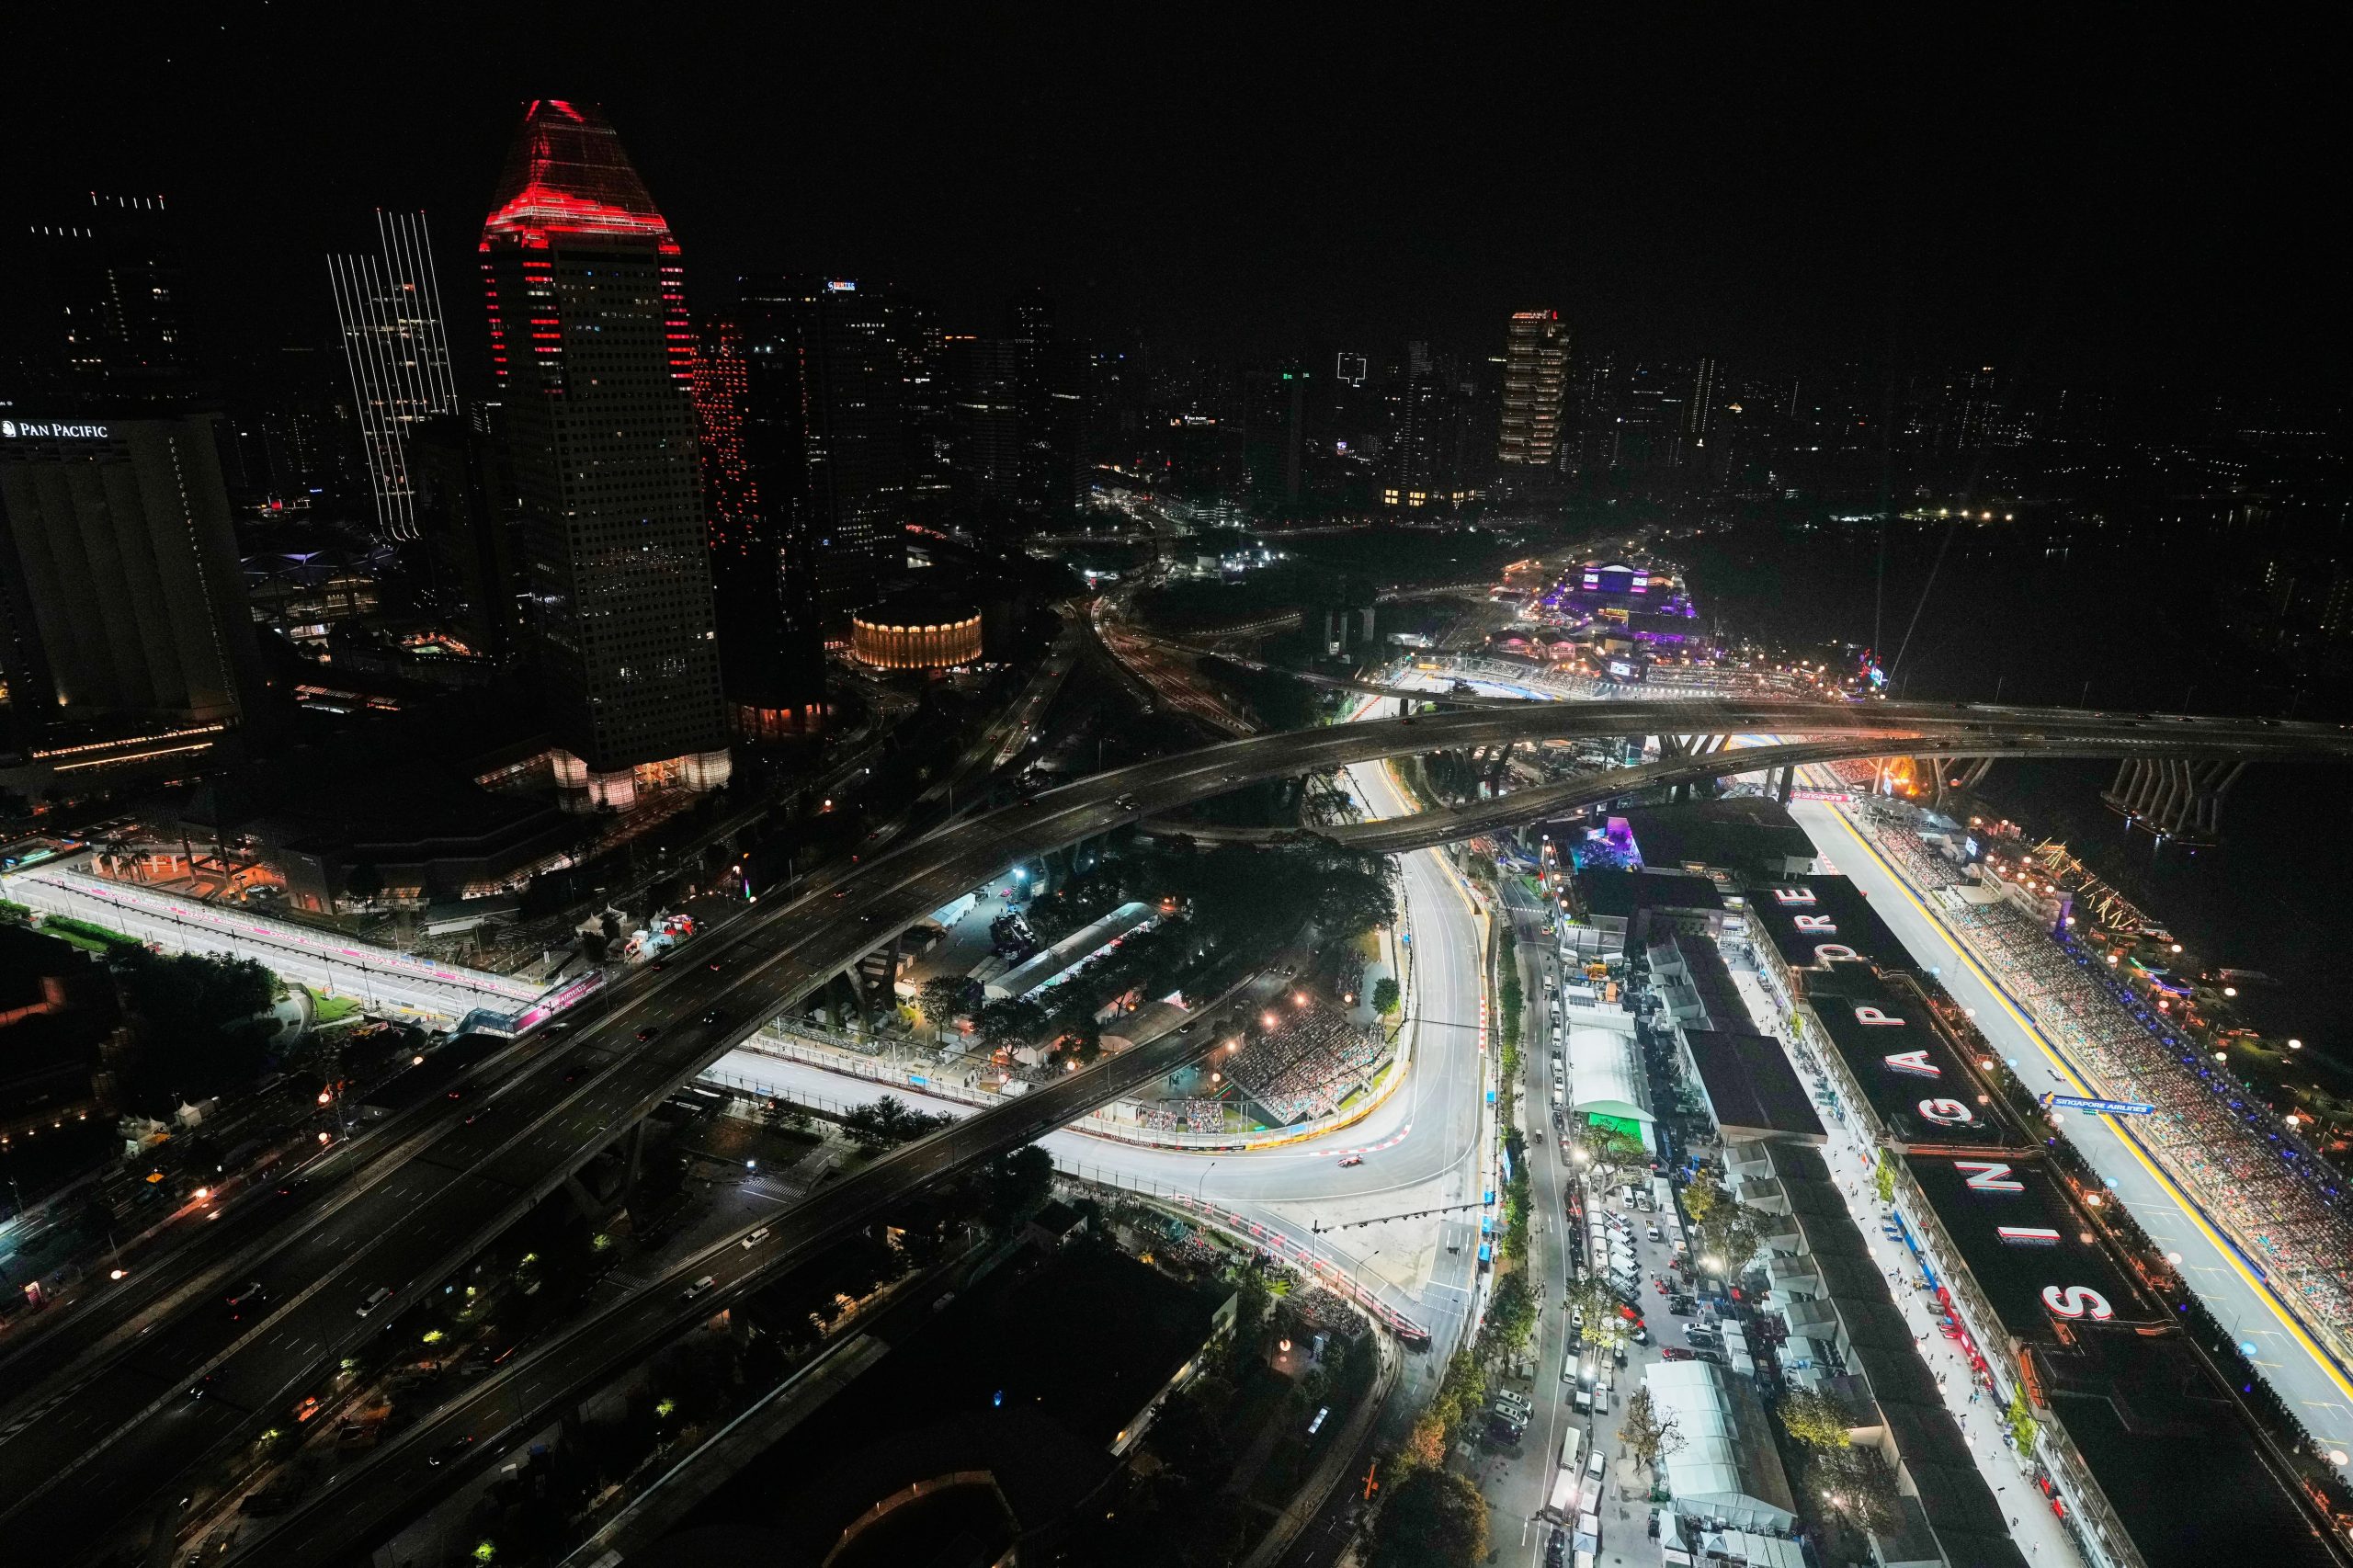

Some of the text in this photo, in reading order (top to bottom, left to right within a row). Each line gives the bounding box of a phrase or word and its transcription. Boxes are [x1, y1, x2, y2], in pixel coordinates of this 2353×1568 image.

[20, 422, 108, 437] PAN PACIFIC
[561, 983, 587, 1003] AIRWAYS
[2056, 1098, 2147, 1113] SINGAPORE AIRLINES
[1110, 1134, 1129, 1143] QATAR
[1130, 1139, 1154, 1148] AIRWAYS
